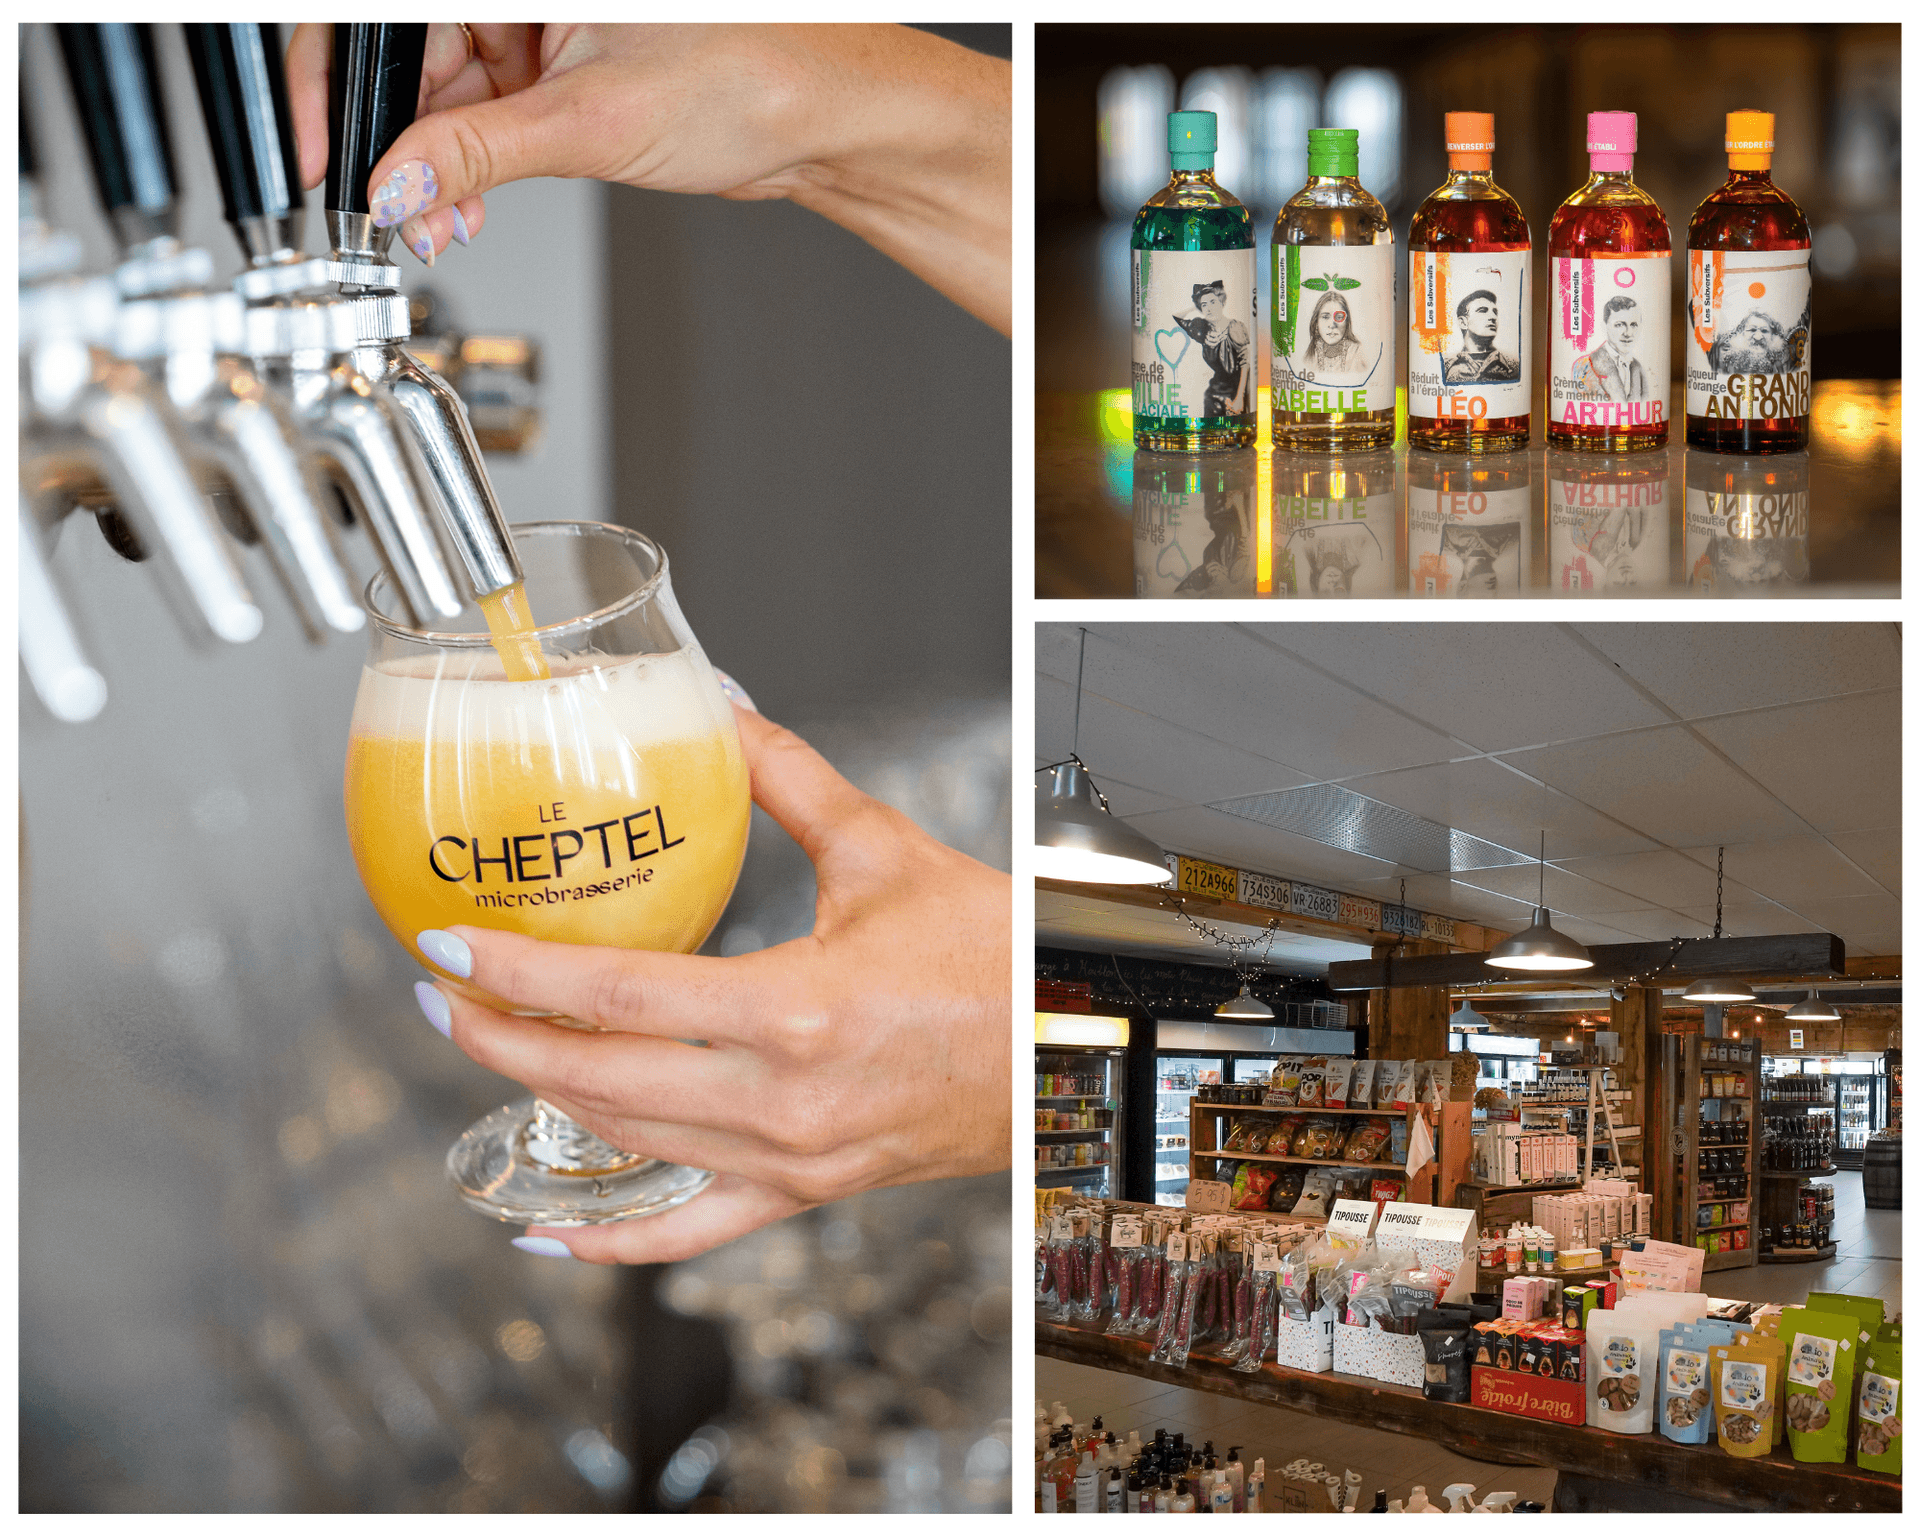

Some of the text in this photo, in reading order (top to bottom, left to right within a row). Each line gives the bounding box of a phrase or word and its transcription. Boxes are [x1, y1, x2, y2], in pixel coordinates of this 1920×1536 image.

[1150, 361, 1164, 374] de
[1299, 368, 1315, 382] de
[1688, 367, 1719, 382] Liqueur
[1411, 371, 1439, 385] Réduit
[1553, 375, 1585, 389] Crème
[1727, 371, 1809, 397] GRAND
[1416, 385, 1456, 397] l'érable
[1688, 379, 1727, 395] d'orange
[1553, 388, 1611, 402] de menthe
[1437, 390, 1487, 419] LÉO
[1705, 393, 1809, 419] ANTONIO
[1563, 400, 1662, 426] ARTHUR
[538, 802, 567, 823] LE
[429, 805, 686, 883] CHEPTEL
[1185, 866, 1235, 894] 212A966
[475, 868, 654, 908] microbrasserie
[1242, 879, 1289, 904] 734S306
[1302, 1073, 1321, 1082] POP
[1334, 1210, 1369, 1223] TIPOUSSE
[1384, 1212, 1423, 1226] TIPOUSSE
[1425, 1217, 1466, 1231] TIPOUSSE
[1393, 1286, 1435, 1300] TIPOUSSE
[1480, 1390, 1574, 1418] Bière froide
